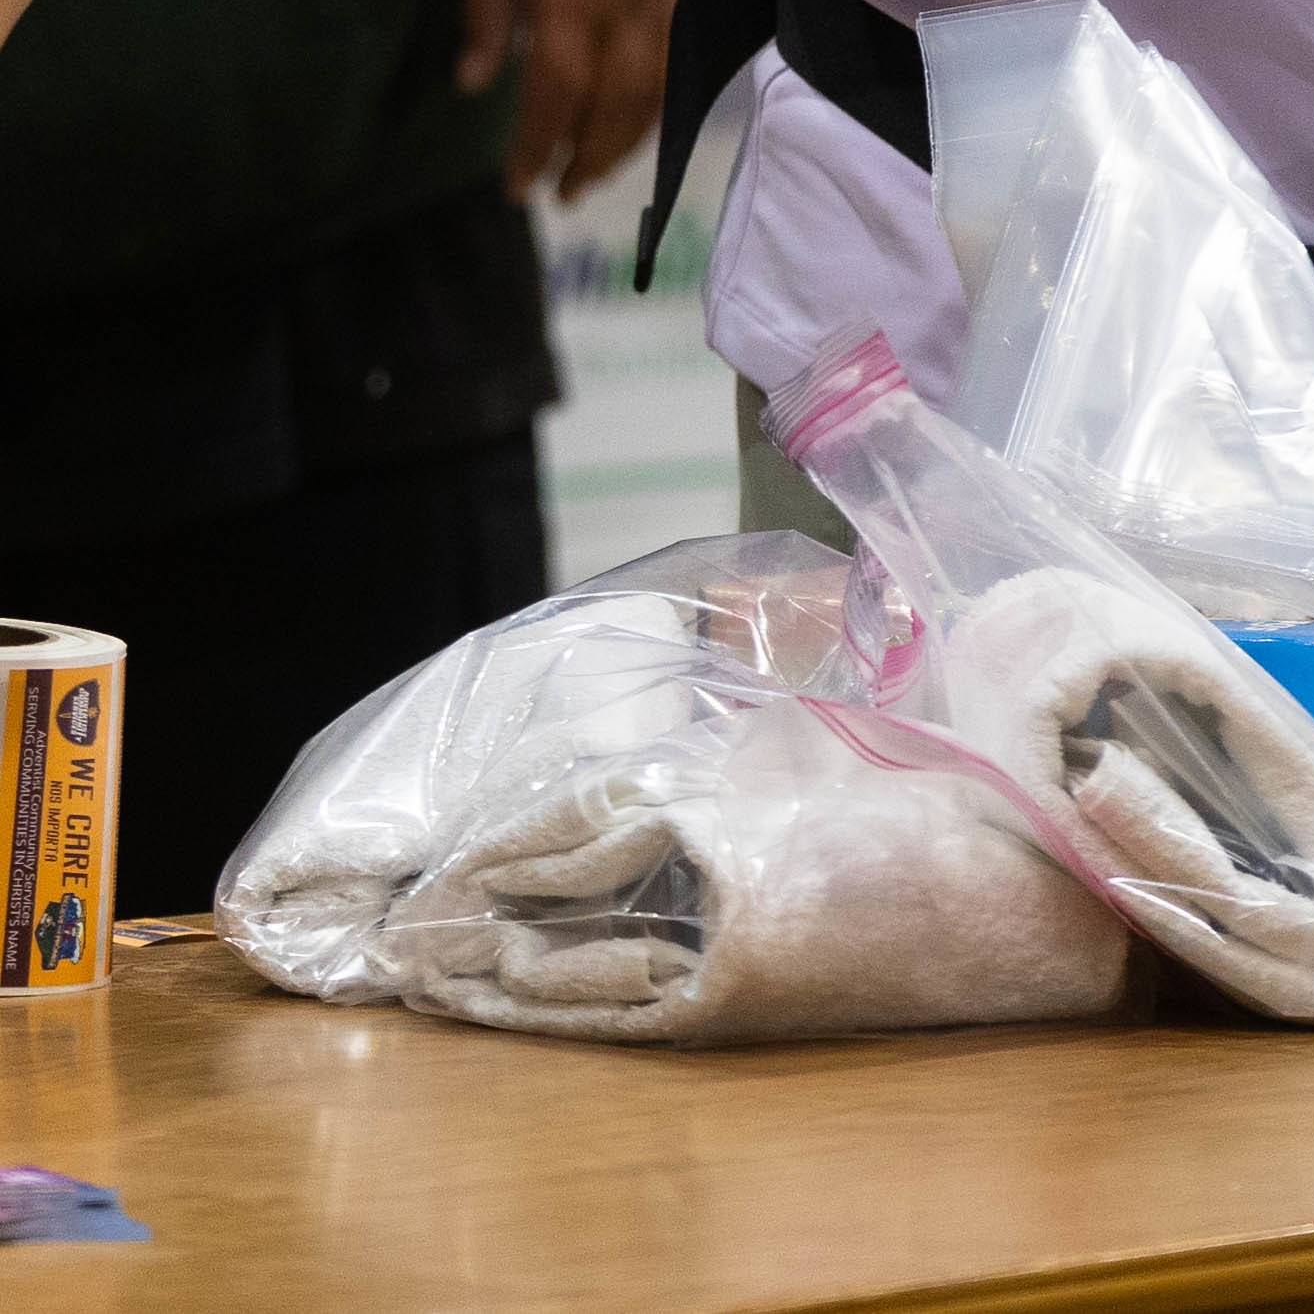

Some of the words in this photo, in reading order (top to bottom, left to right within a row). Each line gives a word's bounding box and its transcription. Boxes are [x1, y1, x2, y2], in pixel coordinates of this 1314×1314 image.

[24, 686, 40, 745] SERVING
[31, 730, 47, 791] Adventist
[68, 758, 96, 801] WE
[15, 748, 34, 847] COMMUNITIES
[50, 780, 62, 804] NOS
[13, 850, 27, 865] IN
[24, 793, 41, 871] Community
[44, 807, 61, 863] IMPORTA
[61, 814, 93, 889] CARE
[9, 869, 25, 927] CHRIST'S
[20, 873, 36, 926] Services
[5, 930, 19, 970] NAME
